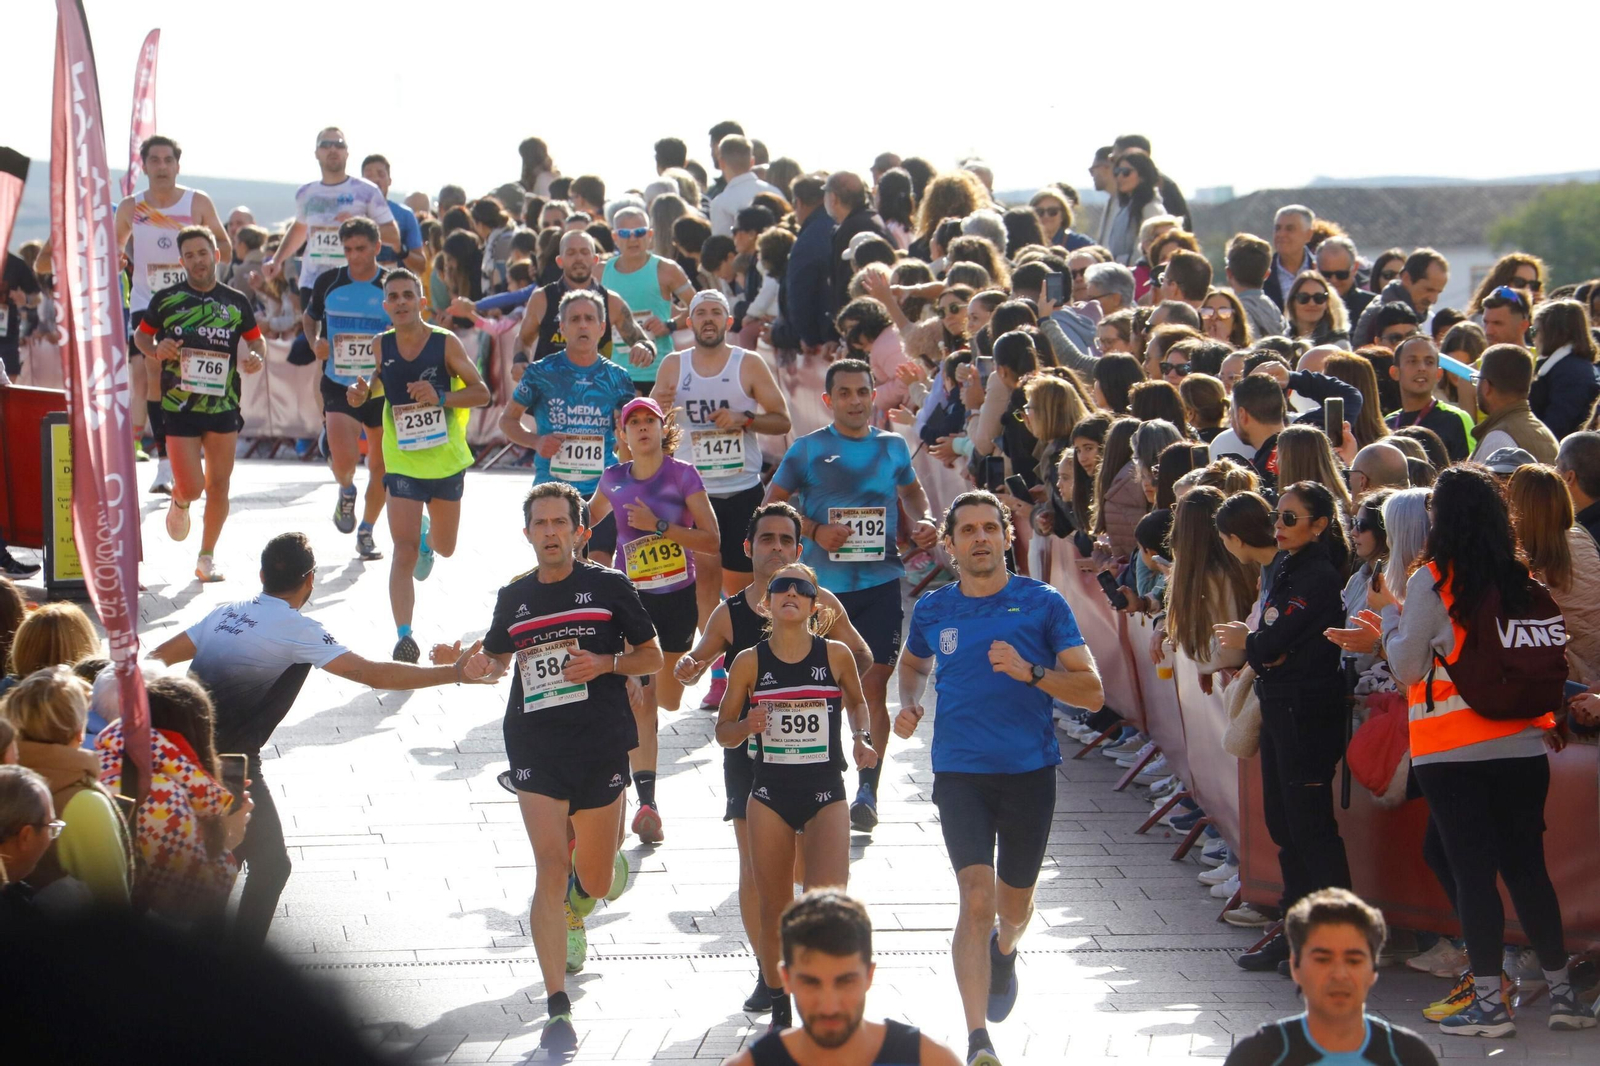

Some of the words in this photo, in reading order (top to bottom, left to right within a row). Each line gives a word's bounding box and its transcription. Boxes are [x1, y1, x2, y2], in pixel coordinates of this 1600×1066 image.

[348, 343, 374, 356] 570
[197, 360, 223, 375] 766
[567, 405, 602, 416] MEDIA
[404, 410, 442, 429] 2387
[565, 445, 603, 460] 1018
[703, 439, 742, 455] 1471
[845, 520, 885, 536] 1192
[640, 543, 682, 565] 1193
[1495, 615, 1567, 648] VANS
[527, 647, 543, 656] MEDIA
[780, 714, 820, 734] 598
